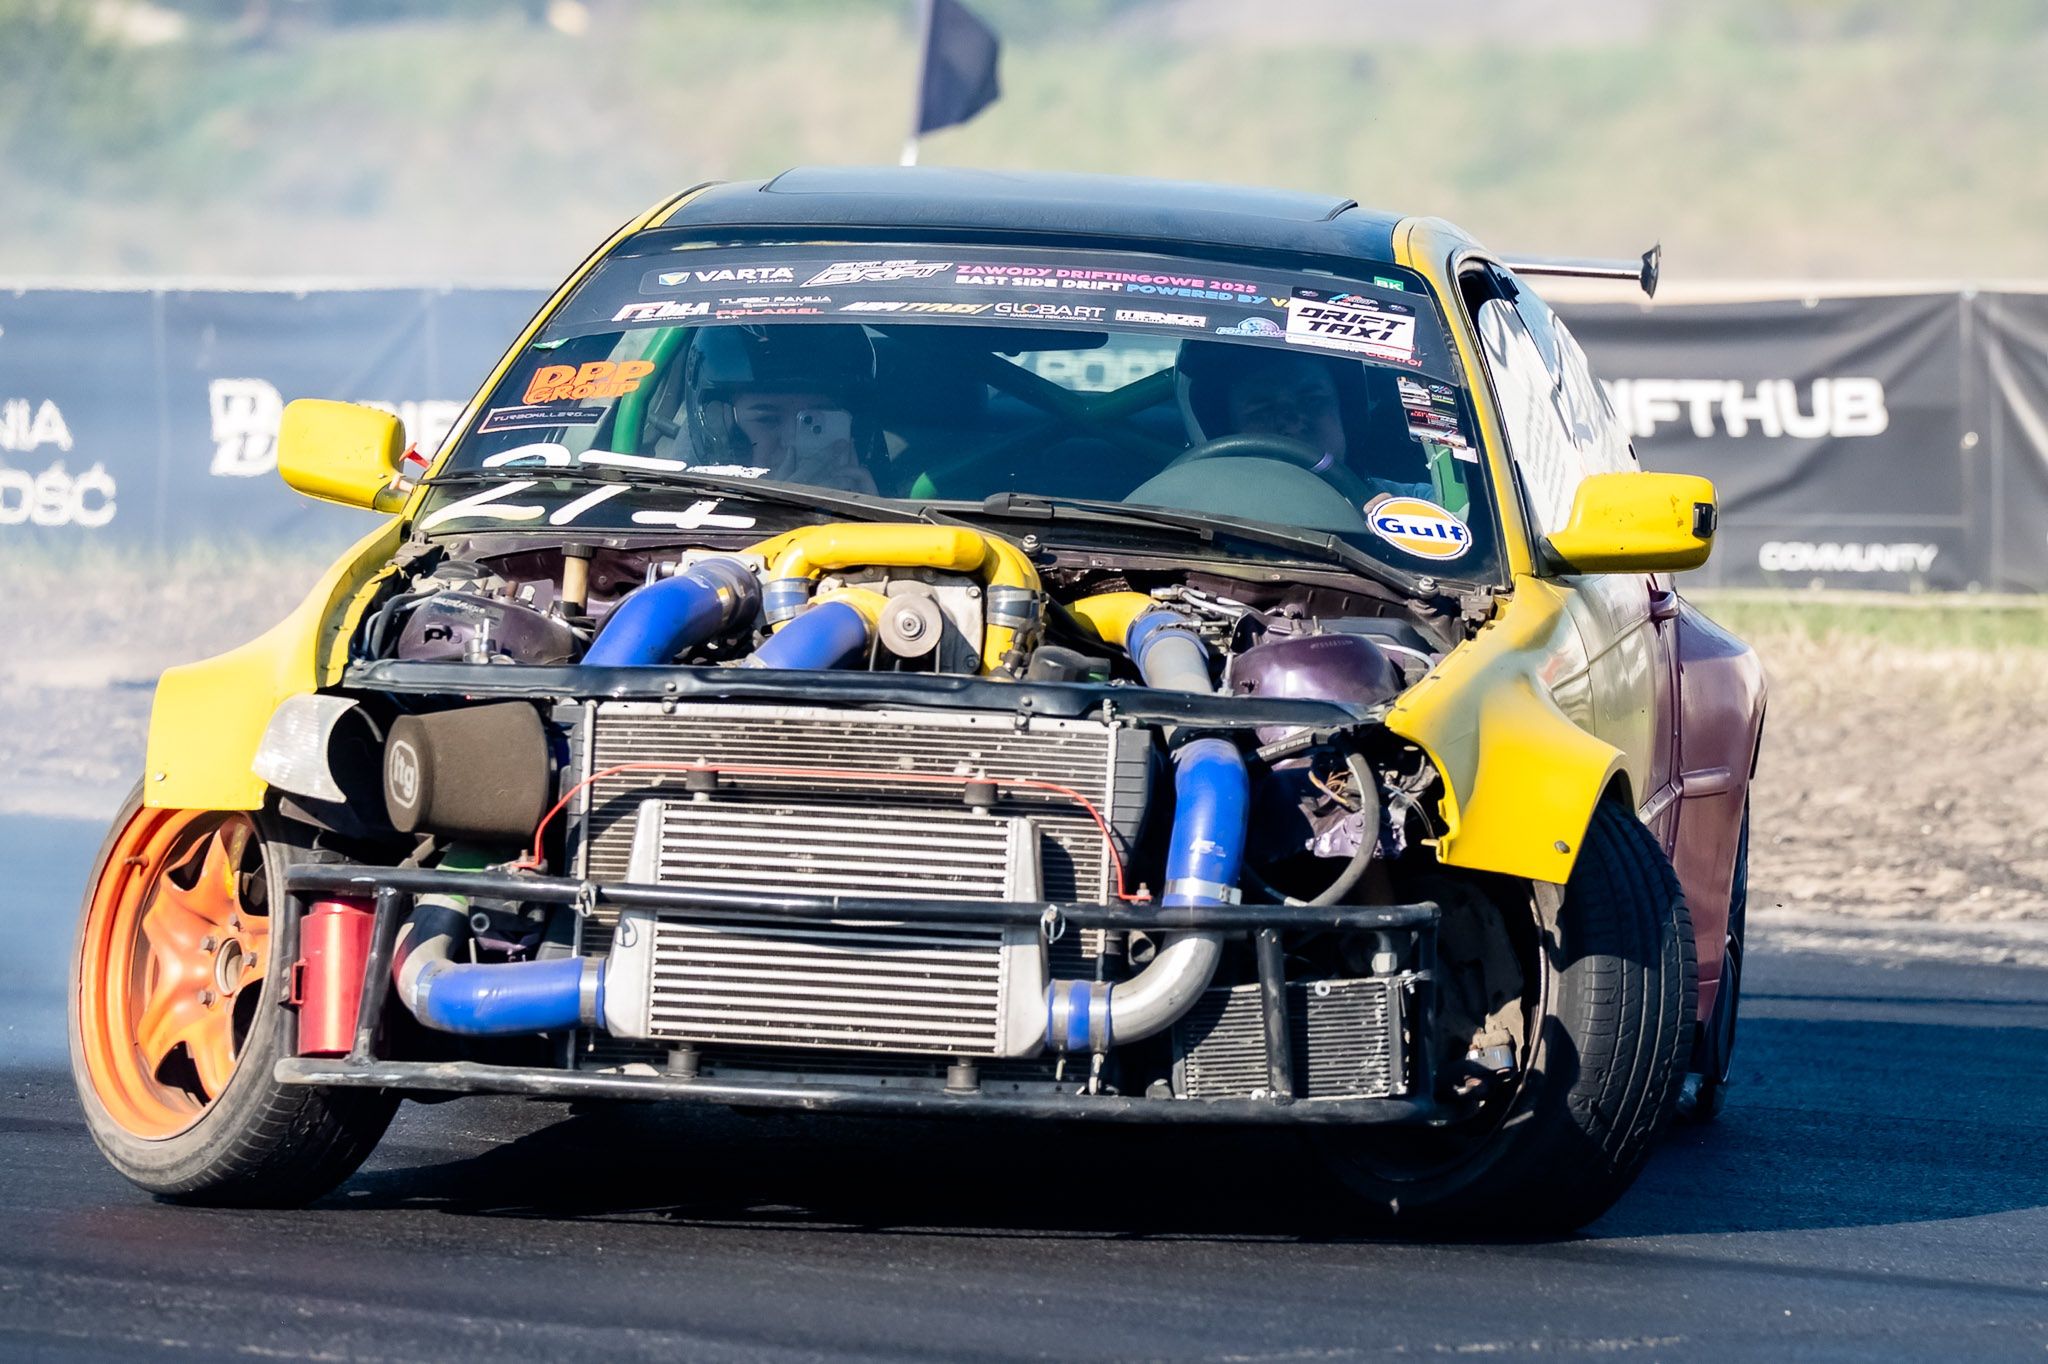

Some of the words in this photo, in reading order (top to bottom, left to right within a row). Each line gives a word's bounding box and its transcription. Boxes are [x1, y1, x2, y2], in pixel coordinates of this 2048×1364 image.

[695, 267, 793, 282] VARTA
[956, 265, 1052, 277] ZAWODY
[1055, 269, 1205, 288] DRIFTINGOWE
[1209, 281, 1257, 293] 2025
[1376, 280, 1402, 291] BK
[955, 275, 1009, 286] EAST
[1012, 276, 1057, 288] SIDE
[1062, 278, 1123, 292] DRIFT
[1126, 284, 1234, 301] POWERED
[1237, 294, 1267, 304] BY
[994, 302, 1106, 318] GLOBART
[1297, 307, 1406, 330] DRIFT
[1308, 320, 1393, 341] TAXI
[530, 360, 655, 387] DPP
[528, 381, 640, 404] GROUP
[1600, 377, 1889, 438] IFTHUB
[1377, 517, 1463, 541] Gulf
[1758, 541, 1939, 574] COMMUNITY
